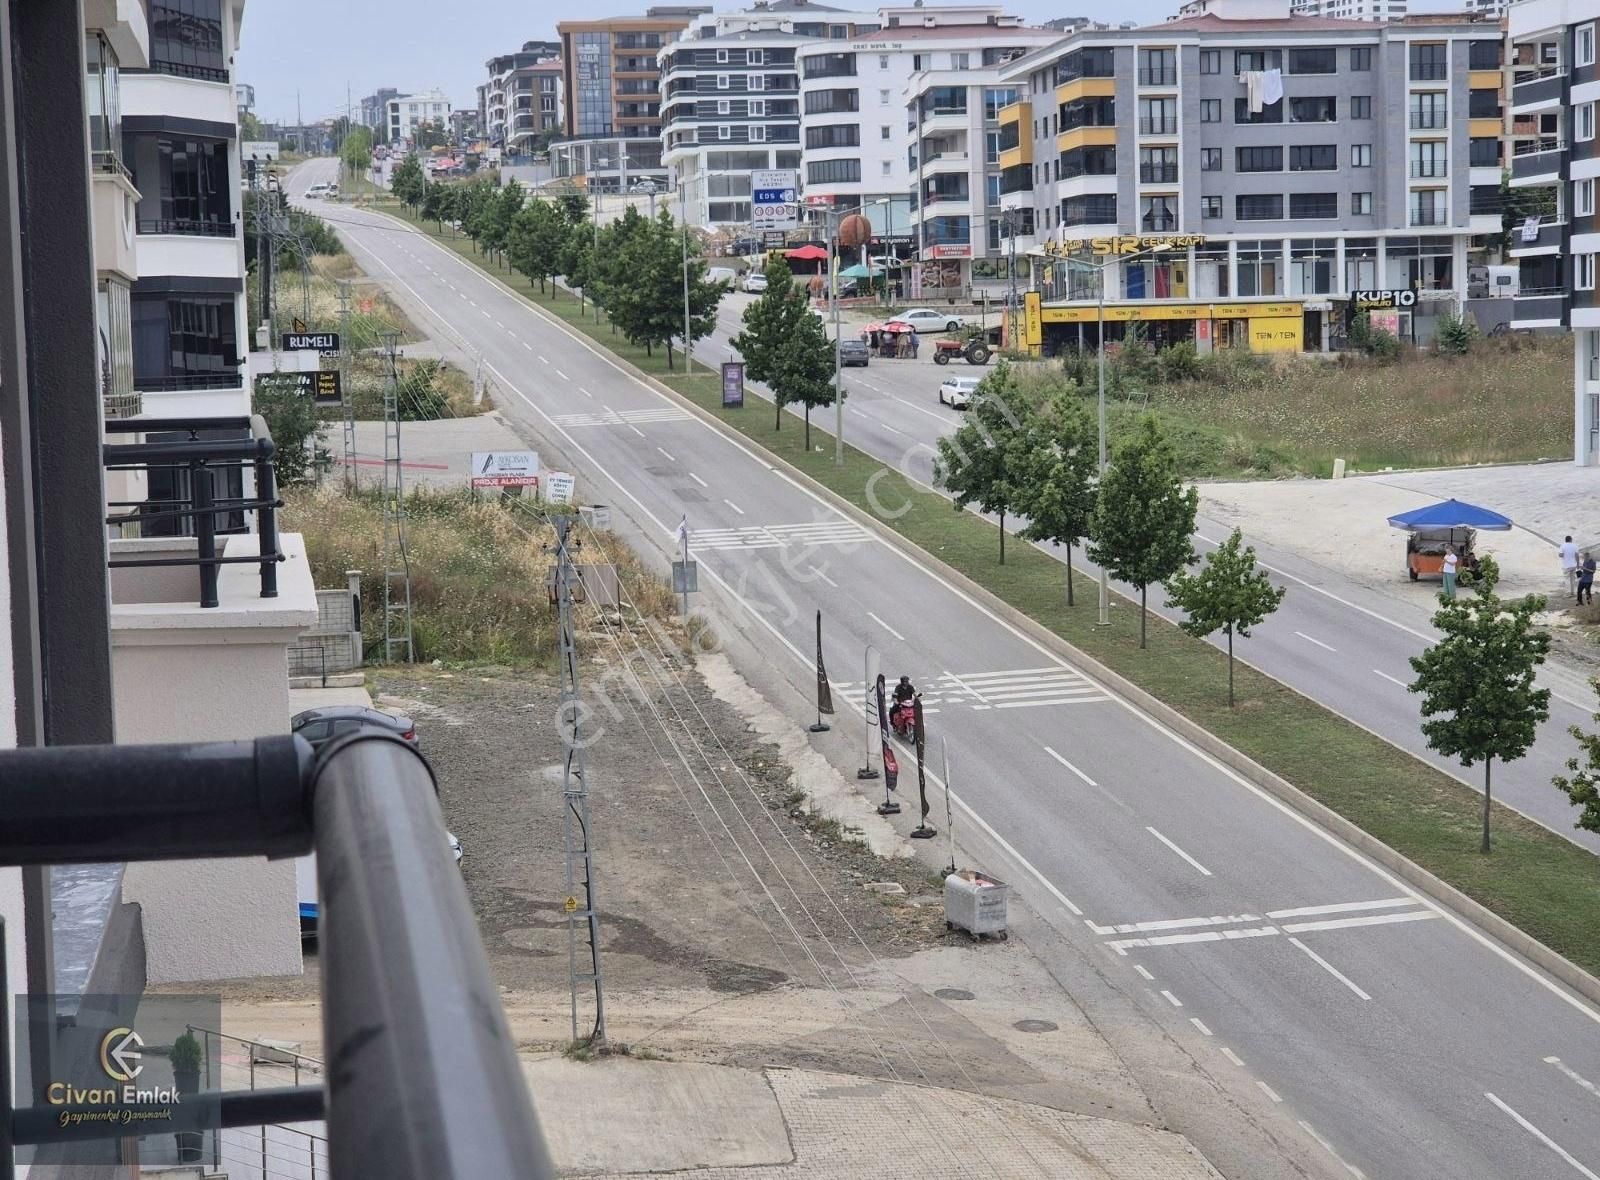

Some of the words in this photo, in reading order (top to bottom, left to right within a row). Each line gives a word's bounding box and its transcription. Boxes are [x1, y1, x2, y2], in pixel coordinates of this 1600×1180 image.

[1356, 291, 1393, 302] KUP
[1393, 290, 1415, 306] 10
[290, 335, 333, 348] RUMELİ
